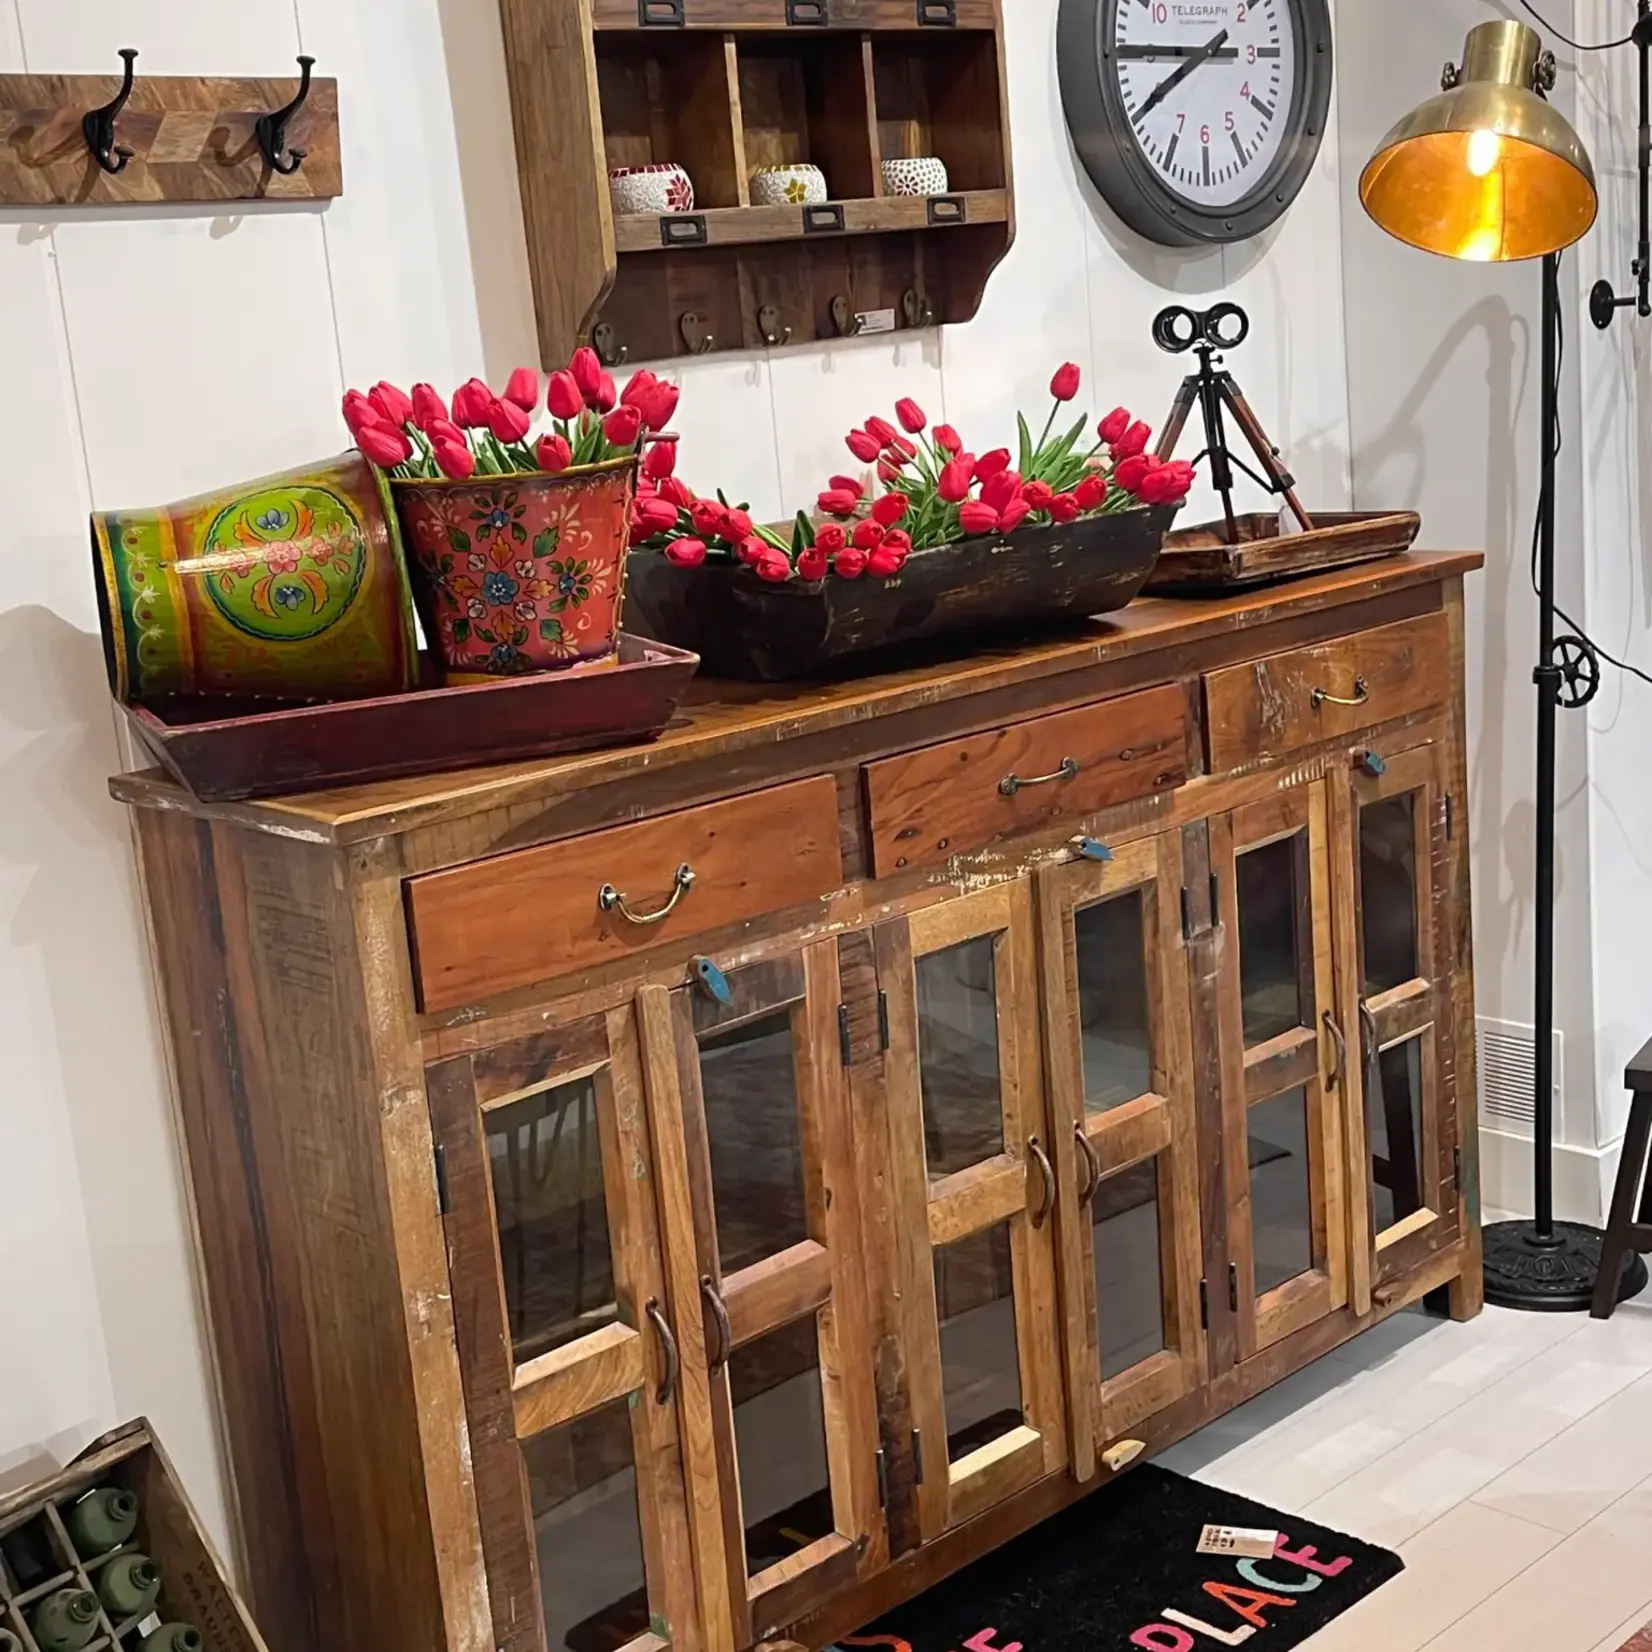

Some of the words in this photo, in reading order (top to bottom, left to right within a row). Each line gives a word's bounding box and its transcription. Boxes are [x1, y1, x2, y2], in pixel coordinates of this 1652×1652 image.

[1152, 3, 1167, 24] 10
[1171, 5, 1228, 17] TELEGRAPH
[1236, 2, 1246, 23] 2
[1246, 44, 1256, 65] 3
[1239, 81, 1250, 101] 4
[1176, 113, 1186, 134] 7
[1224, 111, 1234, 132] 5
[1199, 124, 1210, 145] 6
